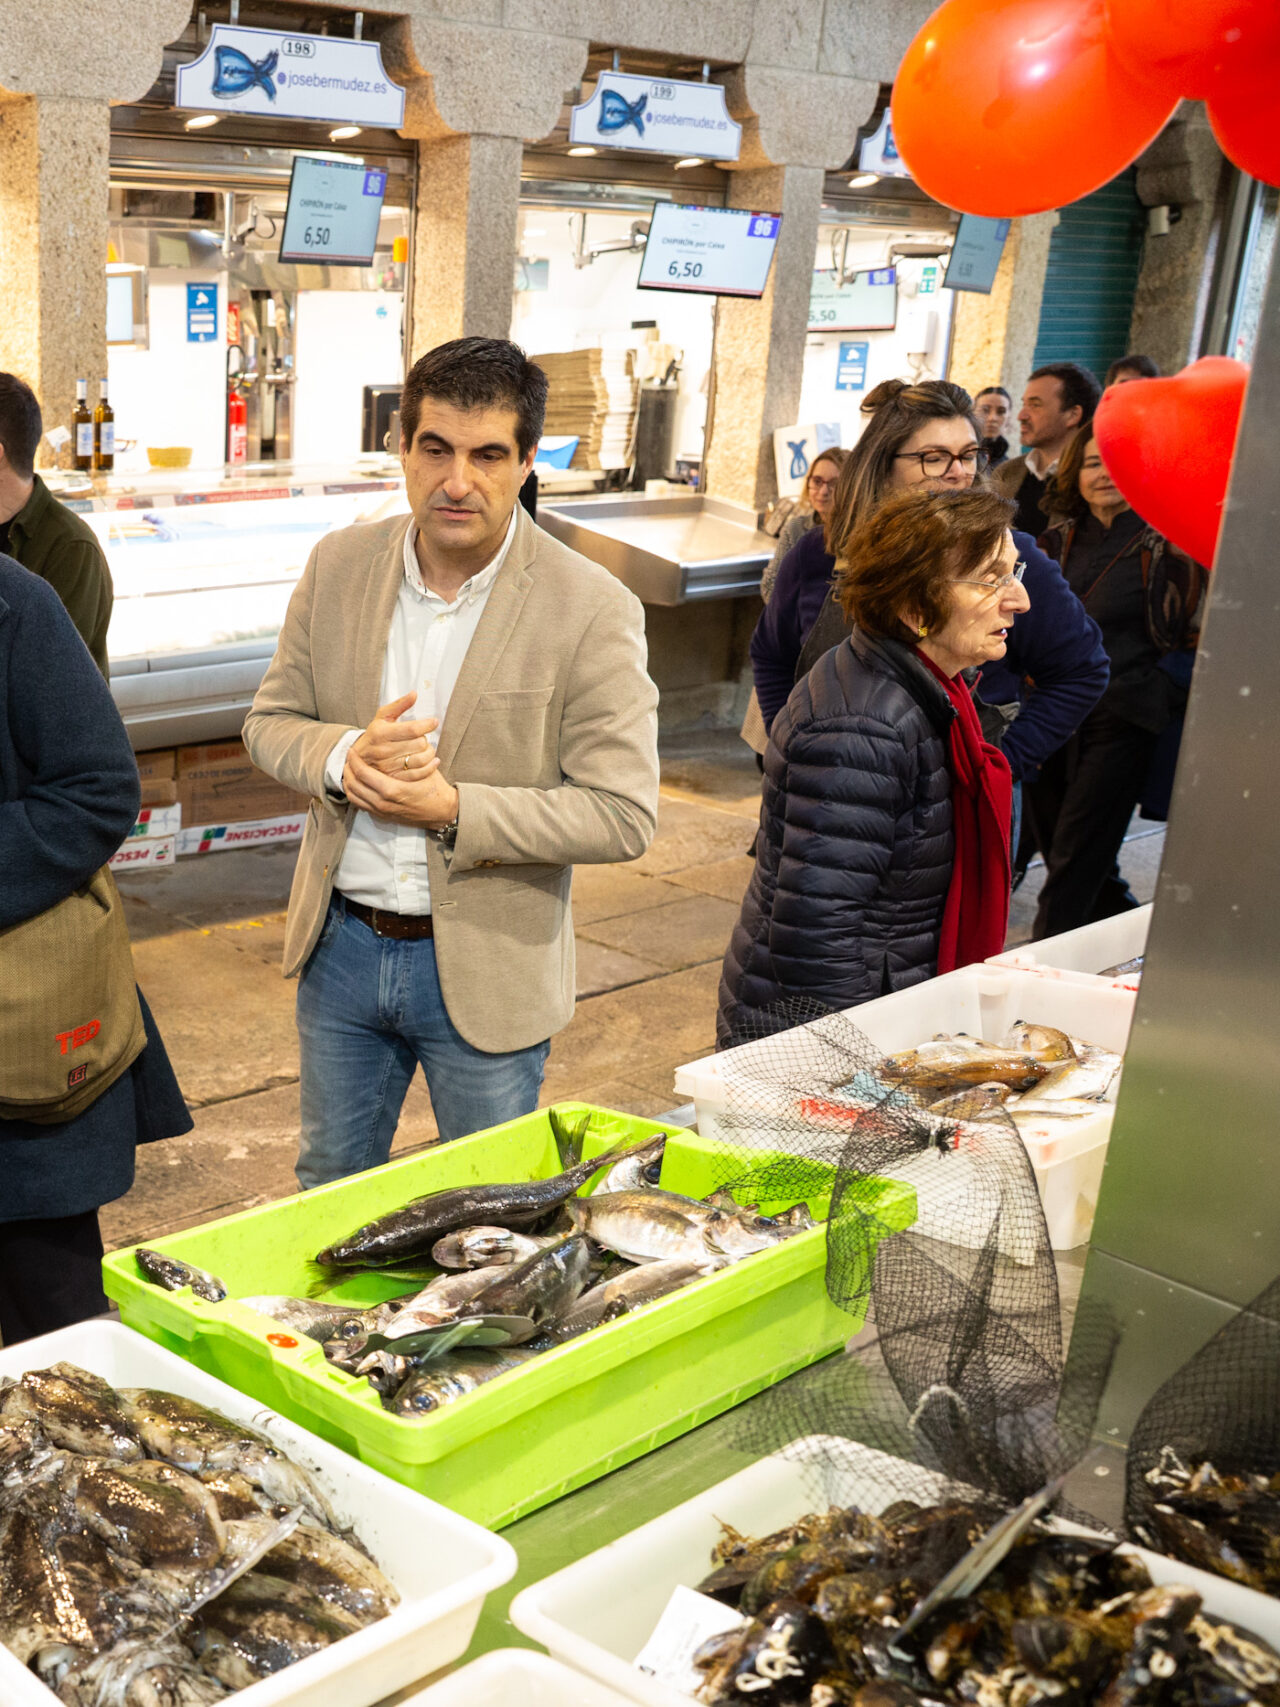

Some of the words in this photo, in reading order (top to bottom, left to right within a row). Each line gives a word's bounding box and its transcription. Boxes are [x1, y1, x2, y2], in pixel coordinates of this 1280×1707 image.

[286, 41, 311, 56] 198
[287, 70, 388, 95] josebermudez.es
[653, 86, 672, 98] 199
[653, 111, 728, 131] josebermudez.es
[303, 225, 331, 248] 6,50
[753, 218, 773, 237] 96
[668, 260, 703, 279] 6,50
[224, 823, 301, 842] PESCACISNE
[55, 1019, 101, 1056] TED
